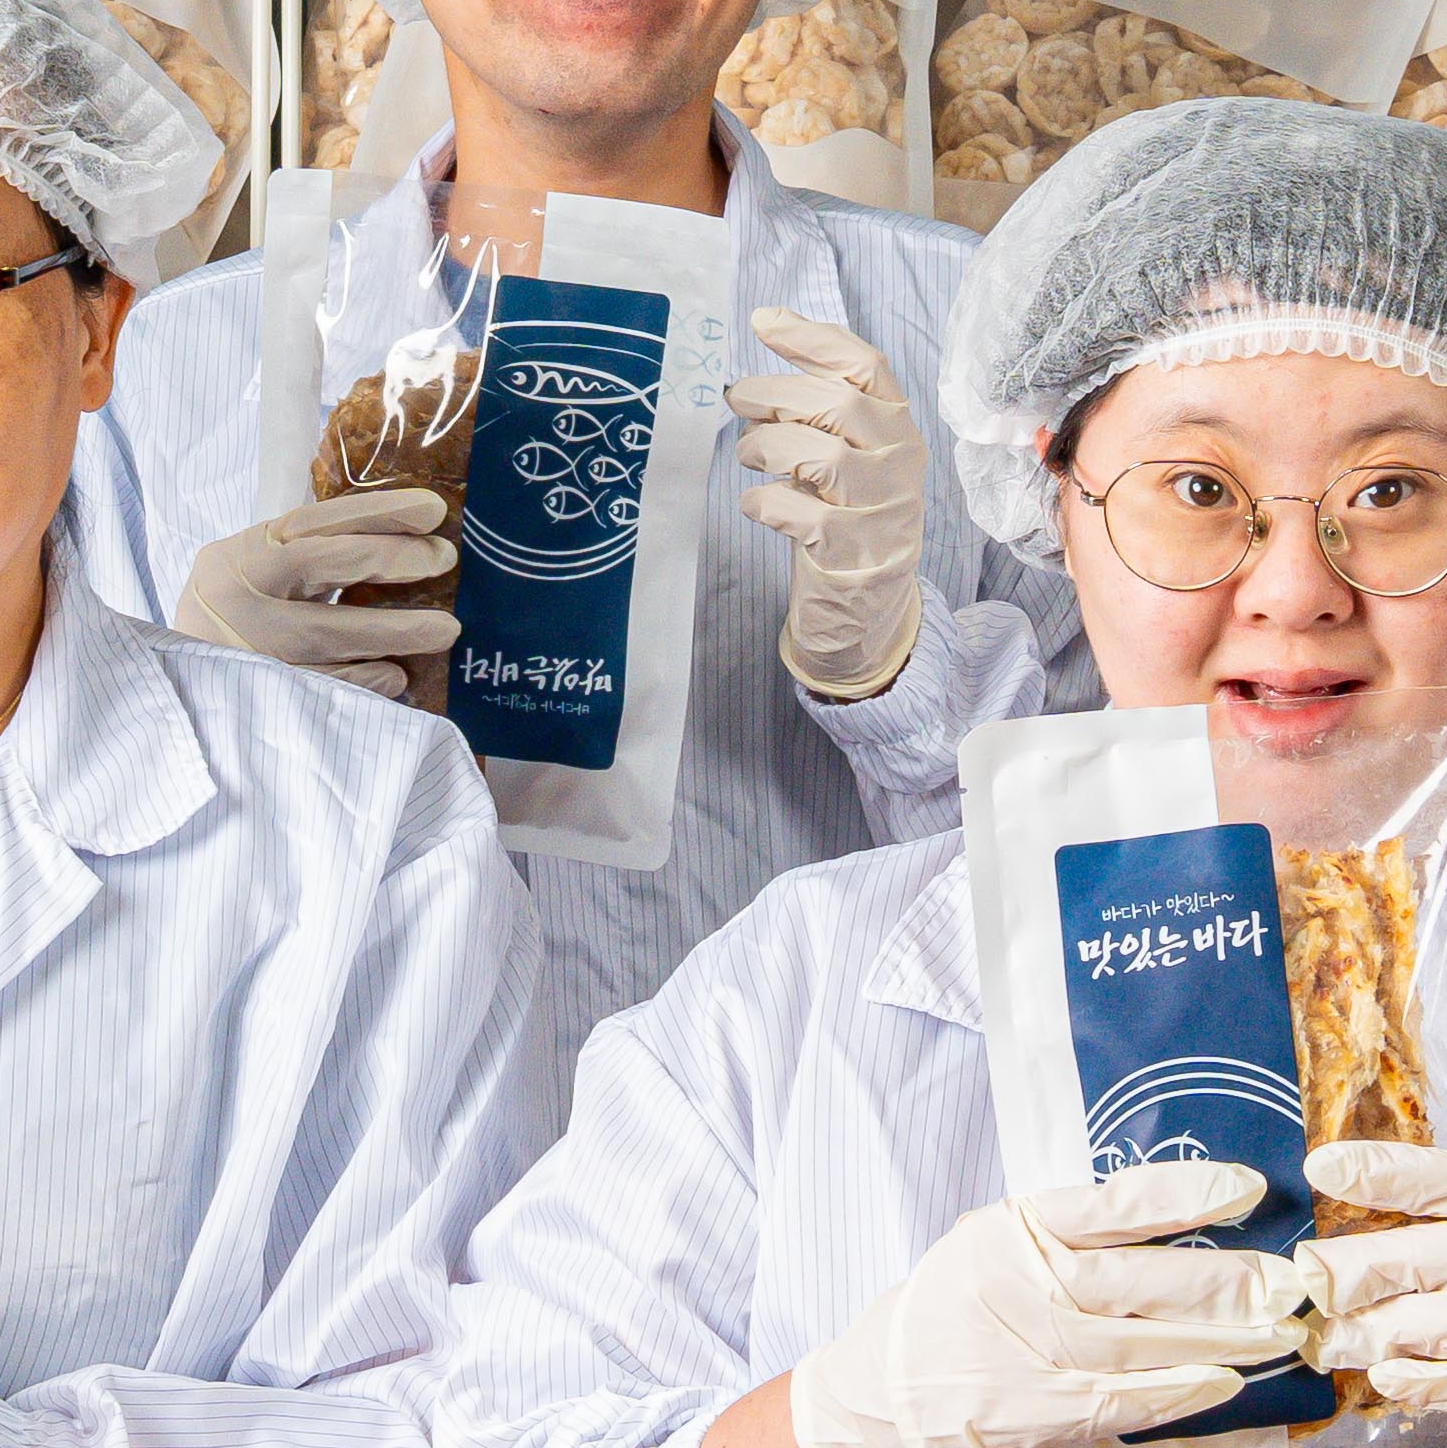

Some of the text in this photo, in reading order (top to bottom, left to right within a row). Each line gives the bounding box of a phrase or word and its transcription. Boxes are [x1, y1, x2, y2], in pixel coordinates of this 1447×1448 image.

[1101, 900, 1162, 922] 바다가
[1077, 910, 1269, 980] 맛있는 바다
